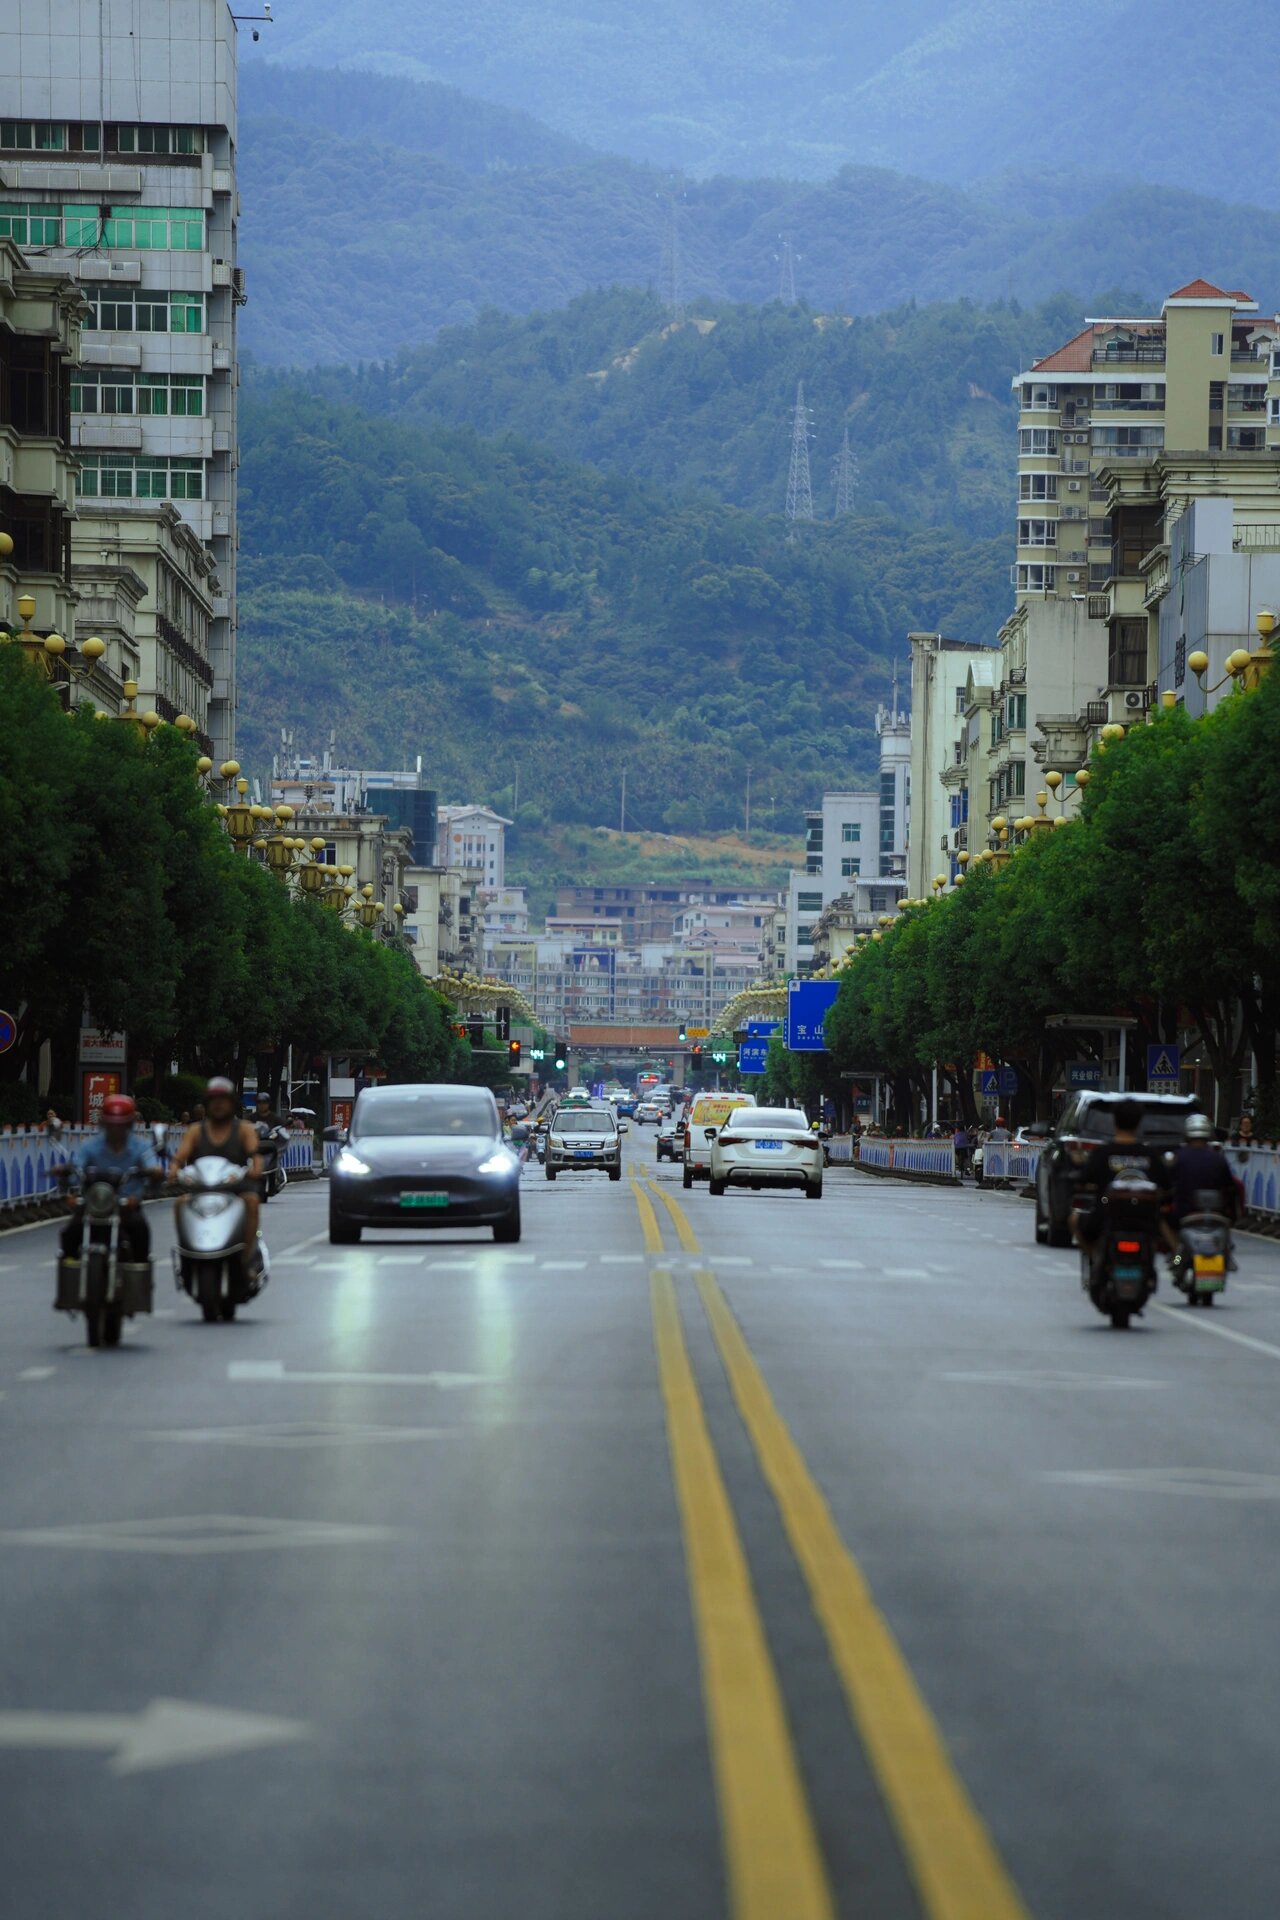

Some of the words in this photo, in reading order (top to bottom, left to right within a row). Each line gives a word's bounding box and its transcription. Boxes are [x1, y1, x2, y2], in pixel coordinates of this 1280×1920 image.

[797, 1025, 824, 1035] 宝山
[530, 1049, 544, 1060] 44
[712, 1053, 726, 1063] 44
[1072, 1070, 1101, 1081] 兴业银行
